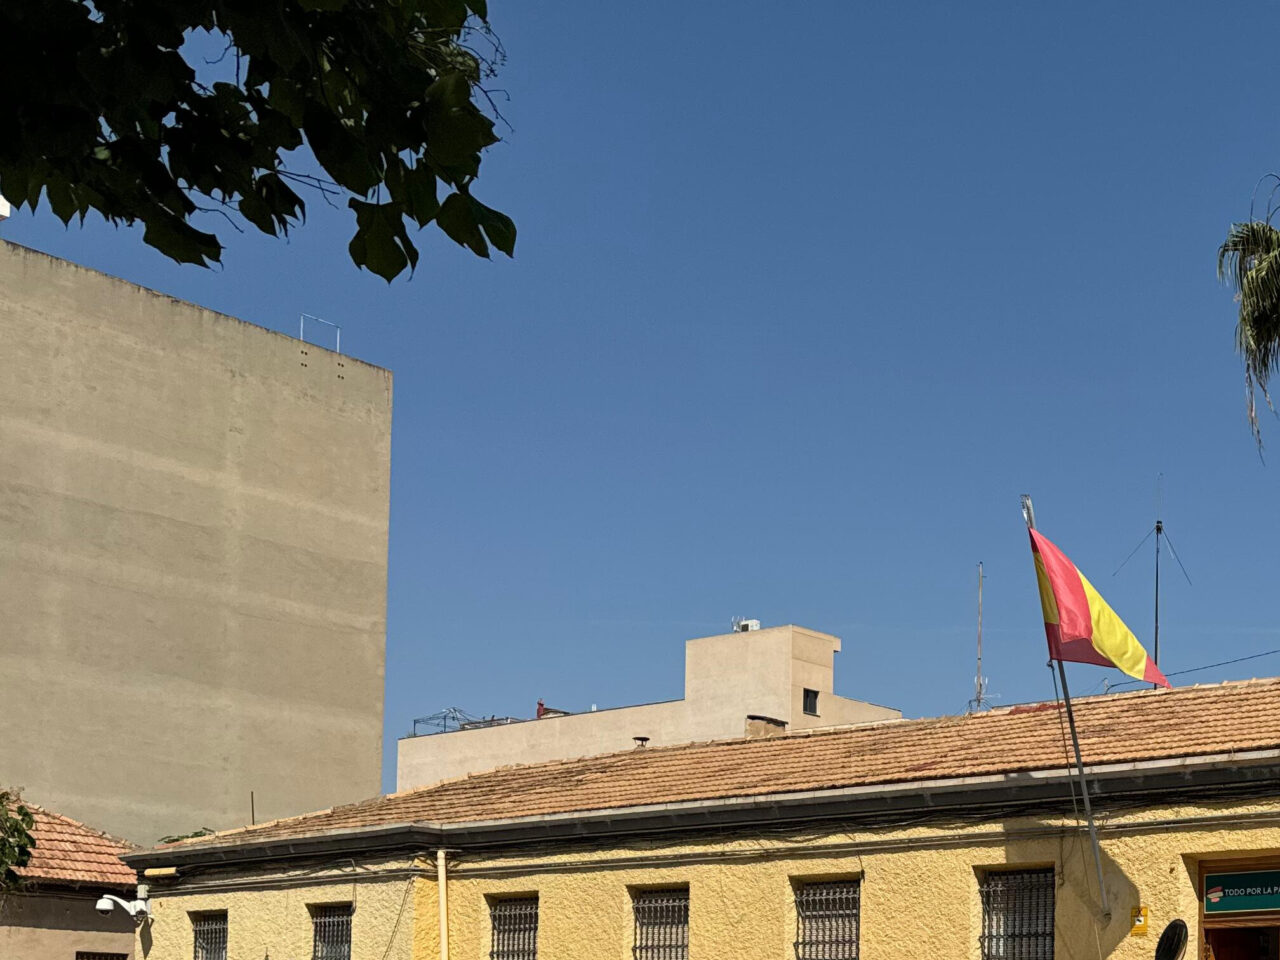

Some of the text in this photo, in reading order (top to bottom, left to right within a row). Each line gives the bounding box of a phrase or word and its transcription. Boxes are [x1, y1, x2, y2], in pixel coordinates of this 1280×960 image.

[1224, 888, 1245, 896] TODO
[1246, 887, 1262, 895] POR
[1263, 886, 1273, 894] LA
